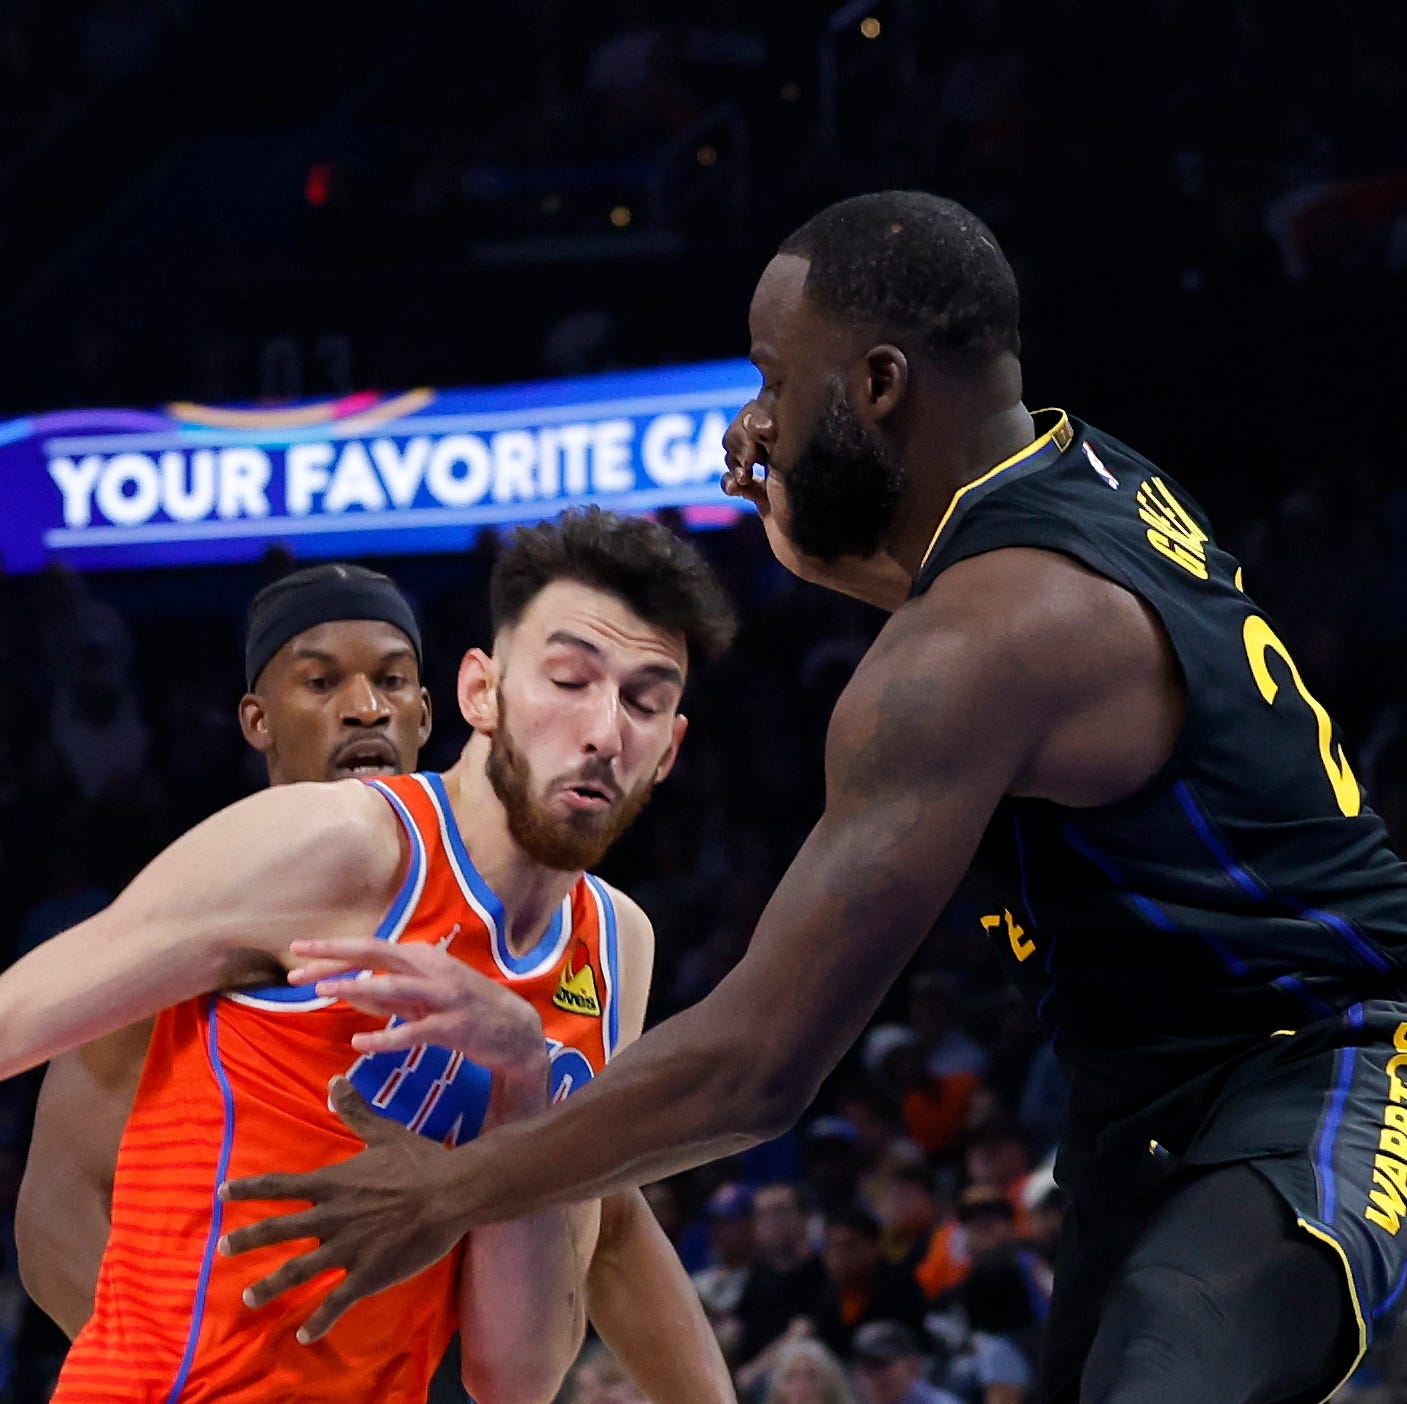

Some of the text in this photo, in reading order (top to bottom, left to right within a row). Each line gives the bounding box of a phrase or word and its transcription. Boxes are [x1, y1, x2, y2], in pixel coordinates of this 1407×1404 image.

[49, 411, 732, 527] YOUR FAVORITE GA
[1234, 565, 1363, 818] 2
